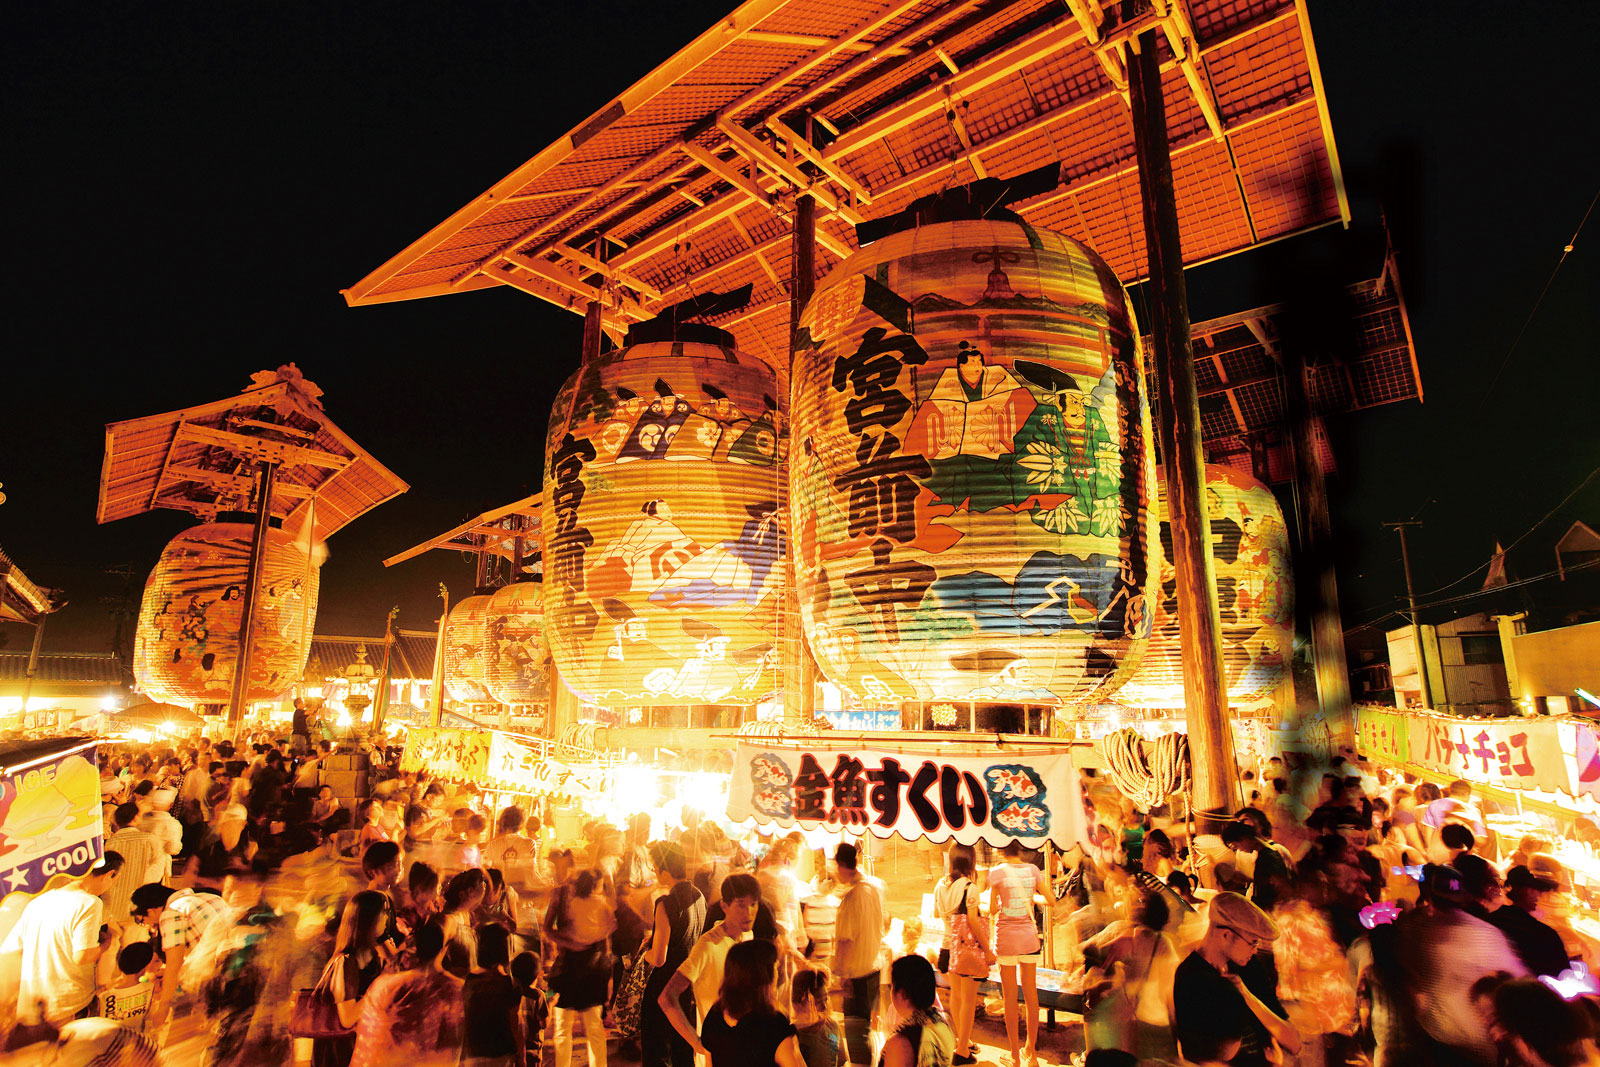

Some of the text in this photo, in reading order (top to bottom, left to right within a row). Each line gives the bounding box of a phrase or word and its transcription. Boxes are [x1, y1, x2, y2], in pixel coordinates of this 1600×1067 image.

[1424, 721, 1535, 777] バナナチョコ
[14, 764, 57, 796] ICE
[791, 753, 990, 832] 金魚すくい
